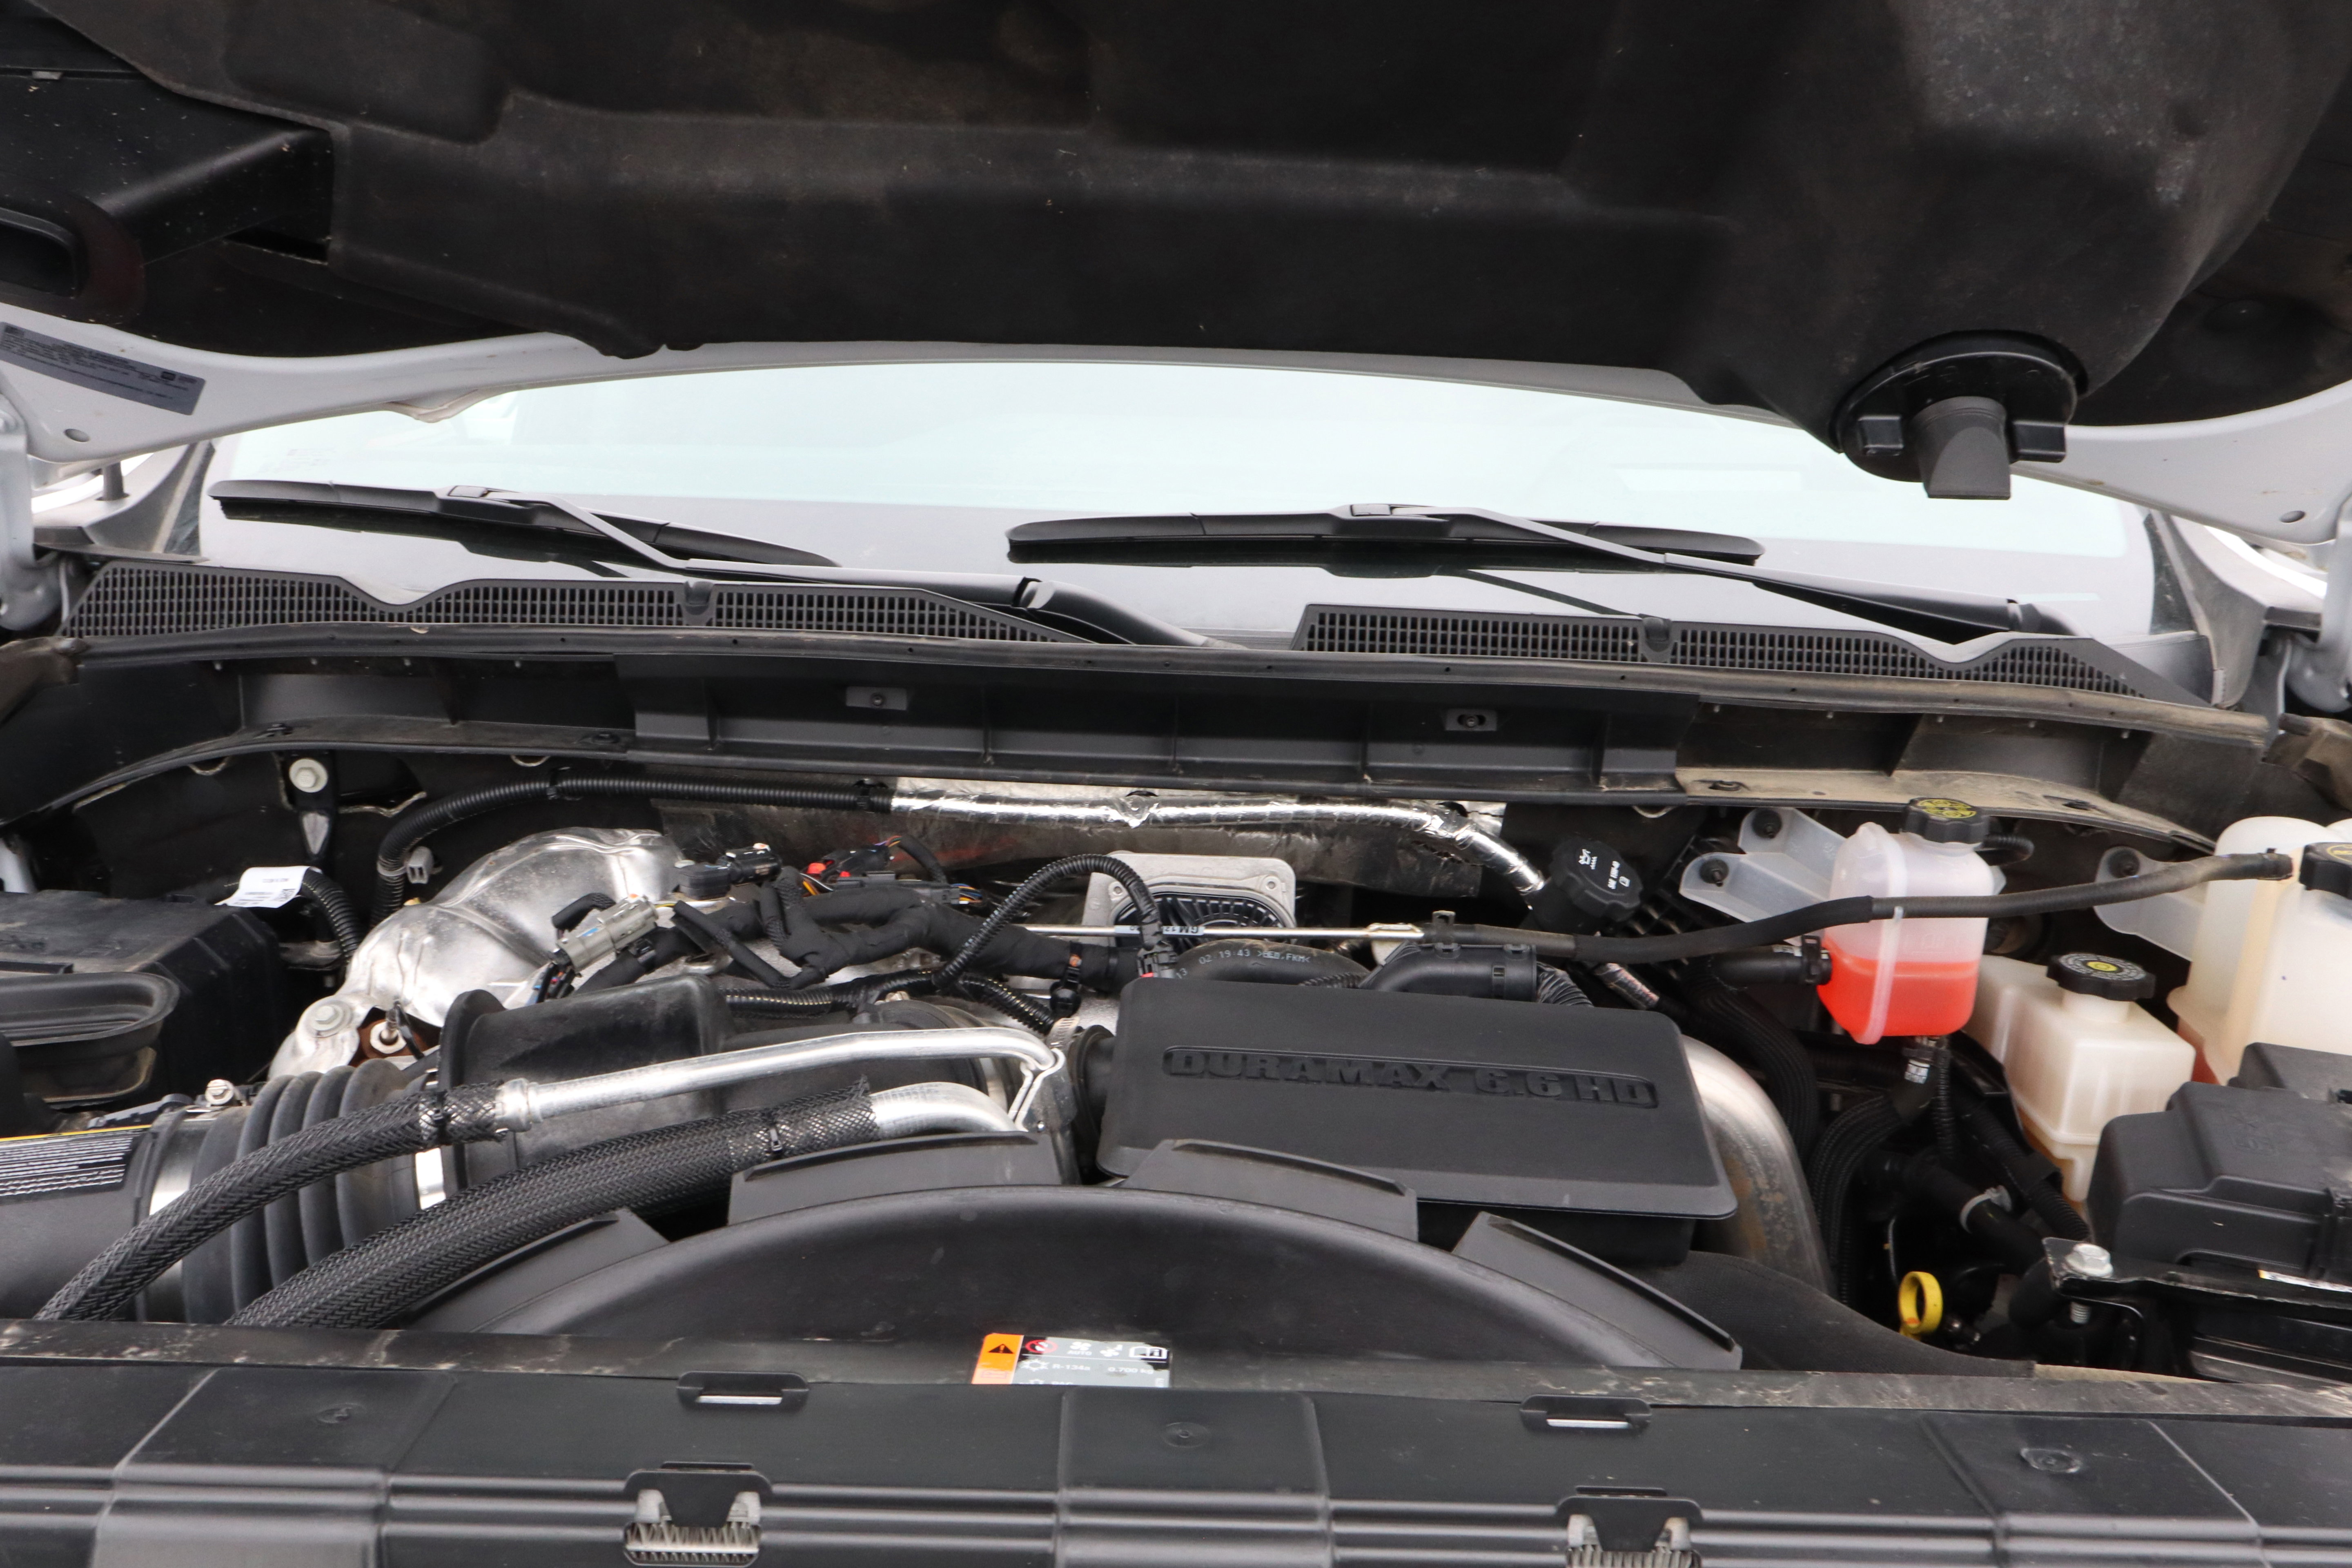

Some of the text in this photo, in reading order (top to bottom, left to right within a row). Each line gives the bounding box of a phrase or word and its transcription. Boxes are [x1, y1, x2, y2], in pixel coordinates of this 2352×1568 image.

[1170, 1051, 1653, 1105] DURAMAX 6.6 HD
